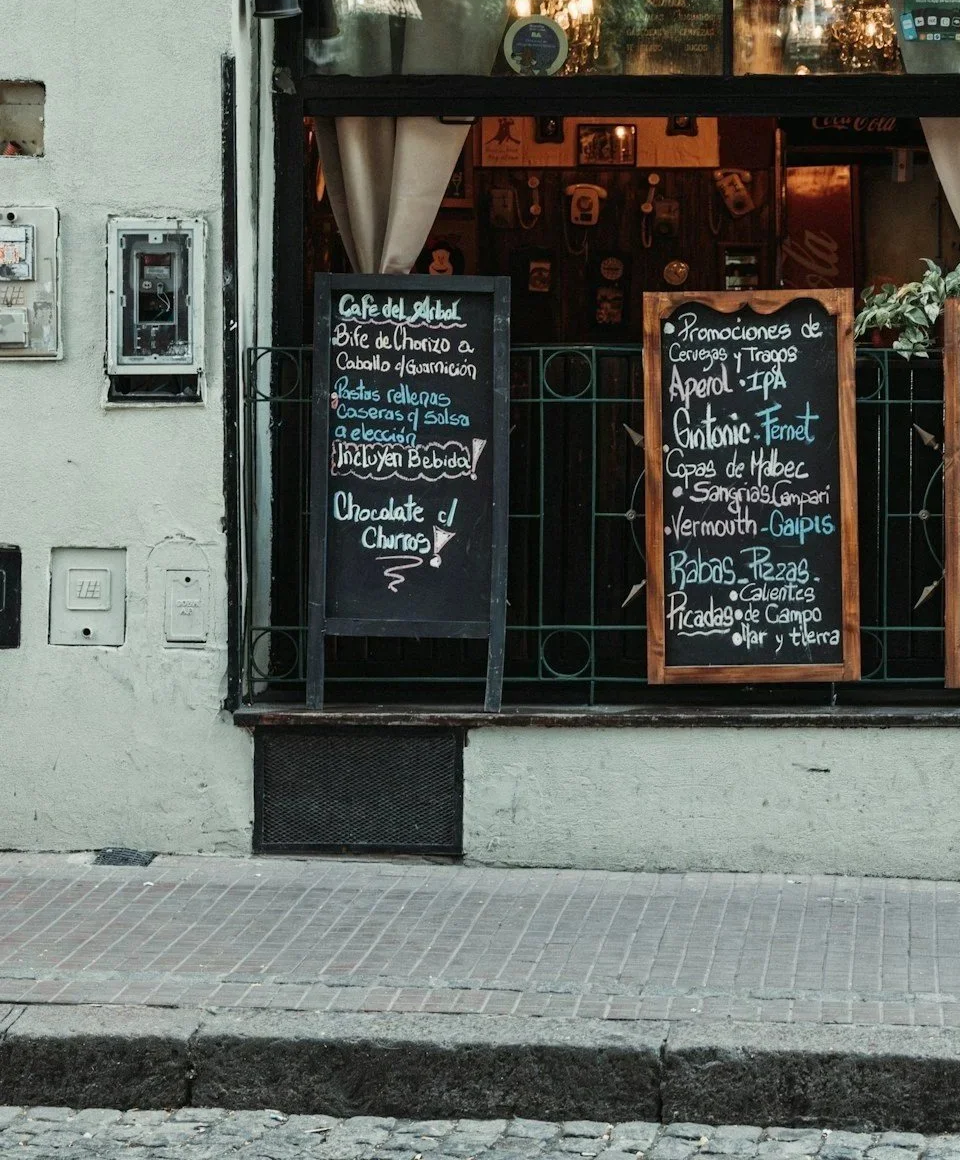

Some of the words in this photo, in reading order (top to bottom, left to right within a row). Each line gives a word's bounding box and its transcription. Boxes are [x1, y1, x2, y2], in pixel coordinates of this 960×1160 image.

[339, 293, 380, 319] Cafe
[382, 297, 406, 320] del
[333, 323, 369, 348] Bife
[375, 331, 392, 349] de
[394, 325, 450, 354] Chorizo
[458, 340, 475, 354] a
[677, 312, 792, 342] Promociones
[801, 313, 823, 339] de
[336, 351, 391, 372] Caballo
[669, 343, 728, 372] Cervezas
[734, 351, 742, 373] y
[741, 346, 798, 371] Tragos
[334, 375, 380, 401] Pastas
[387, 383, 451, 408] rellenas
[669, 363, 733, 409] Aperol
[746, 369, 787, 400] IPA
[336, 403, 404, 420] Caseras
[755, 402, 820, 446] Fernet
[335, 425, 347, 439] a
[350, 422, 416, 448] elección
[337, 443, 402, 472] Incluyen
[666, 447, 717, 489] Copas
[726, 448, 745, 479] de
[750, 447, 809, 486] Malbec
[333, 491, 424, 523] Chocolate
[438, 497, 458, 527] c/
[769, 480, 831, 516] Campari
[671, 506, 757, 540] Vermouth
[669, 548, 735, 590] Rabas
[739, 546, 810, 584] Pizzas
[739, 583, 815, 602] Calientes
[666, 591, 734, 631] Picadas
[744, 603, 760, 622] de
[765, 604, 822, 627] Campo
[741, 621, 768, 649] Mar
[775, 636, 784, 654] y
[789, 628, 840, 647] tierra
